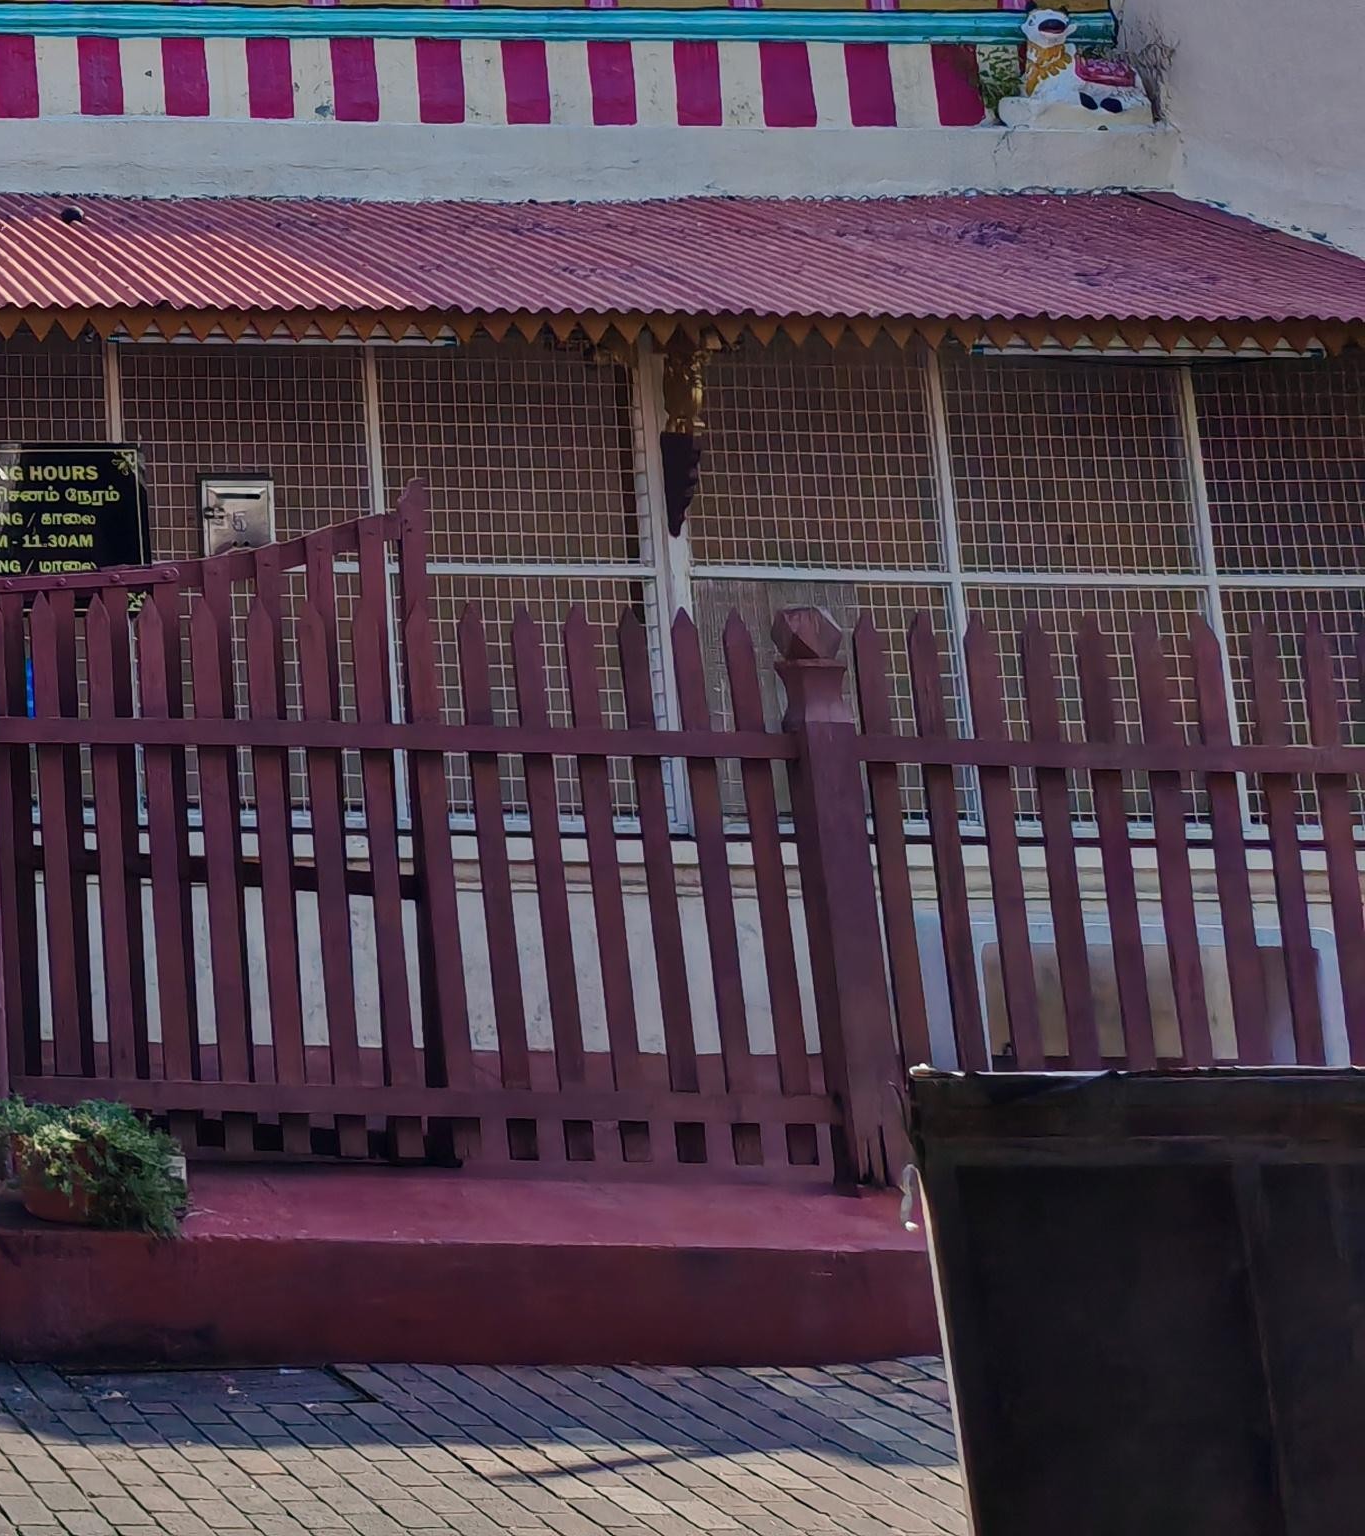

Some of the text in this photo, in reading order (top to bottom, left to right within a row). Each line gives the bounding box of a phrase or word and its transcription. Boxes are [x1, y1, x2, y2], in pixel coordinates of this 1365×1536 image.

[29, 466, 99, 481] HOURS
[65, 485, 120, 505] நேரம்
[41, 513, 96, 526] காலை
[22, 535, 94, 548] 11.30AM
